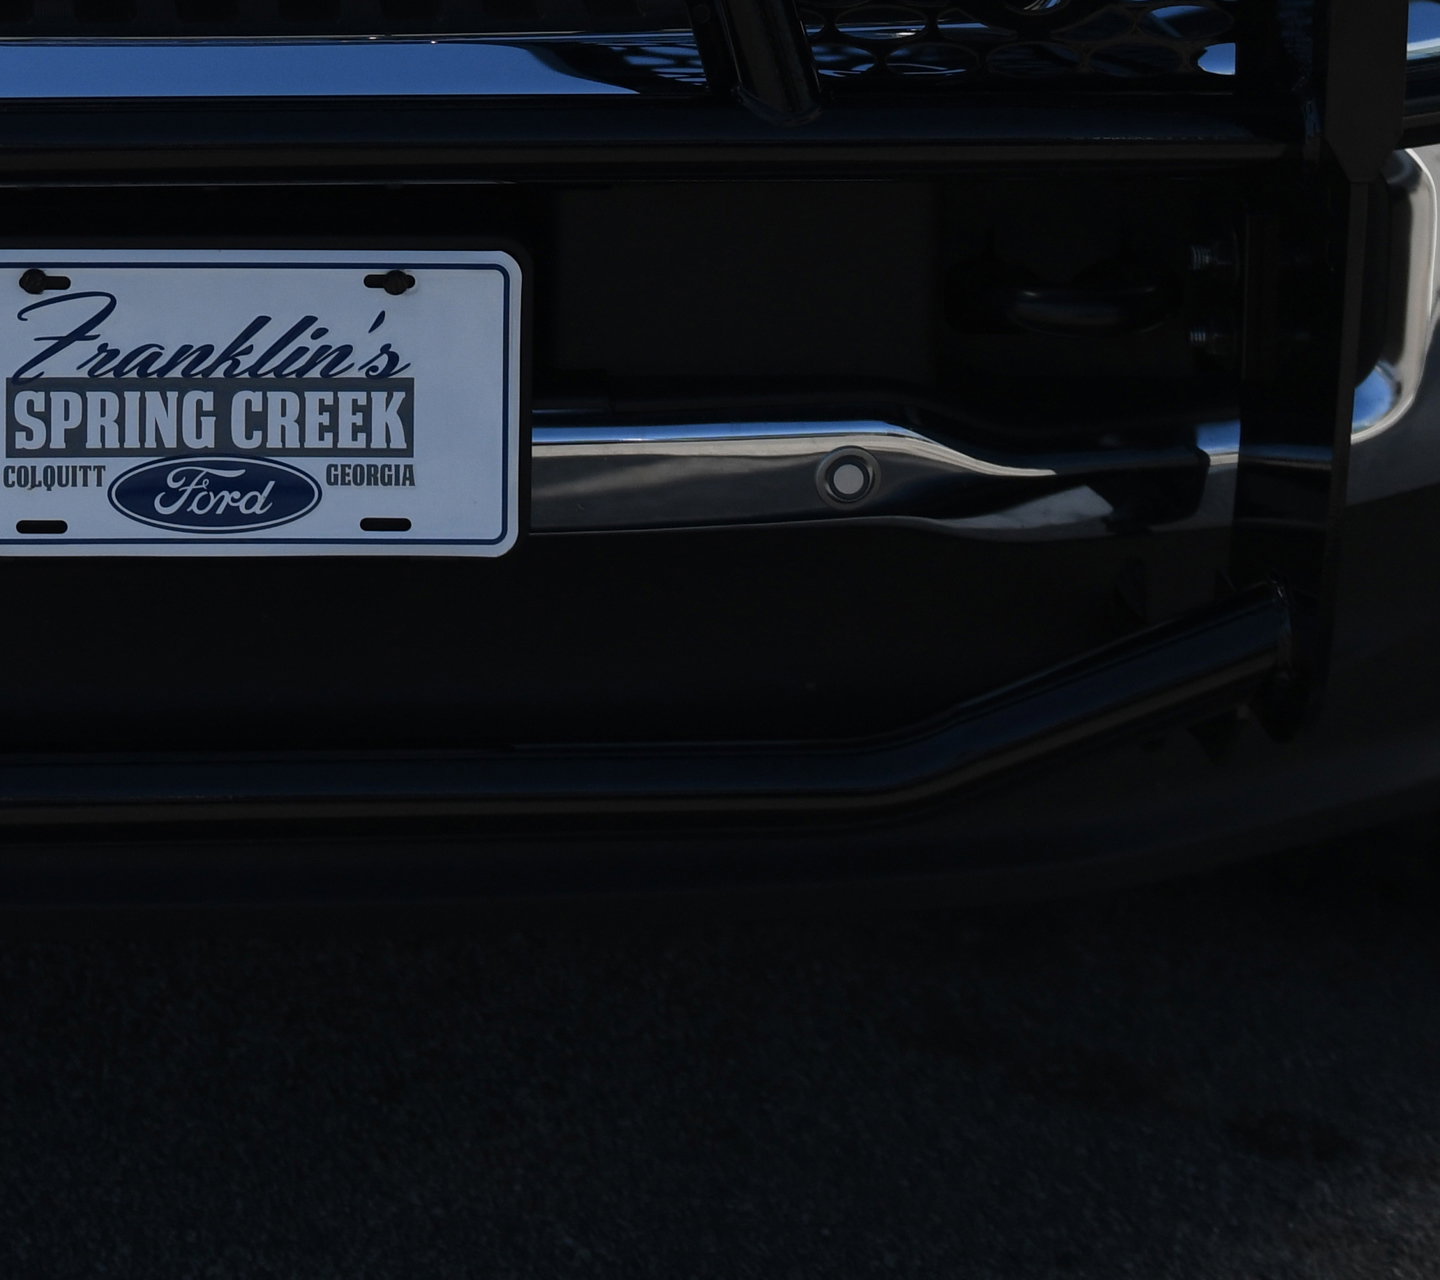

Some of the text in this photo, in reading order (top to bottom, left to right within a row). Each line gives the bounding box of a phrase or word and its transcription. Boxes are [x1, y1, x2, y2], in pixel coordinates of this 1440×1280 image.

[15, 290, 412, 382] Franklin's
[14, 389, 409, 451] SPRING CREEK
[2, 463, 416, 491] COLQUITT GEORGIA
[153, 466, 273, 517] Ford
